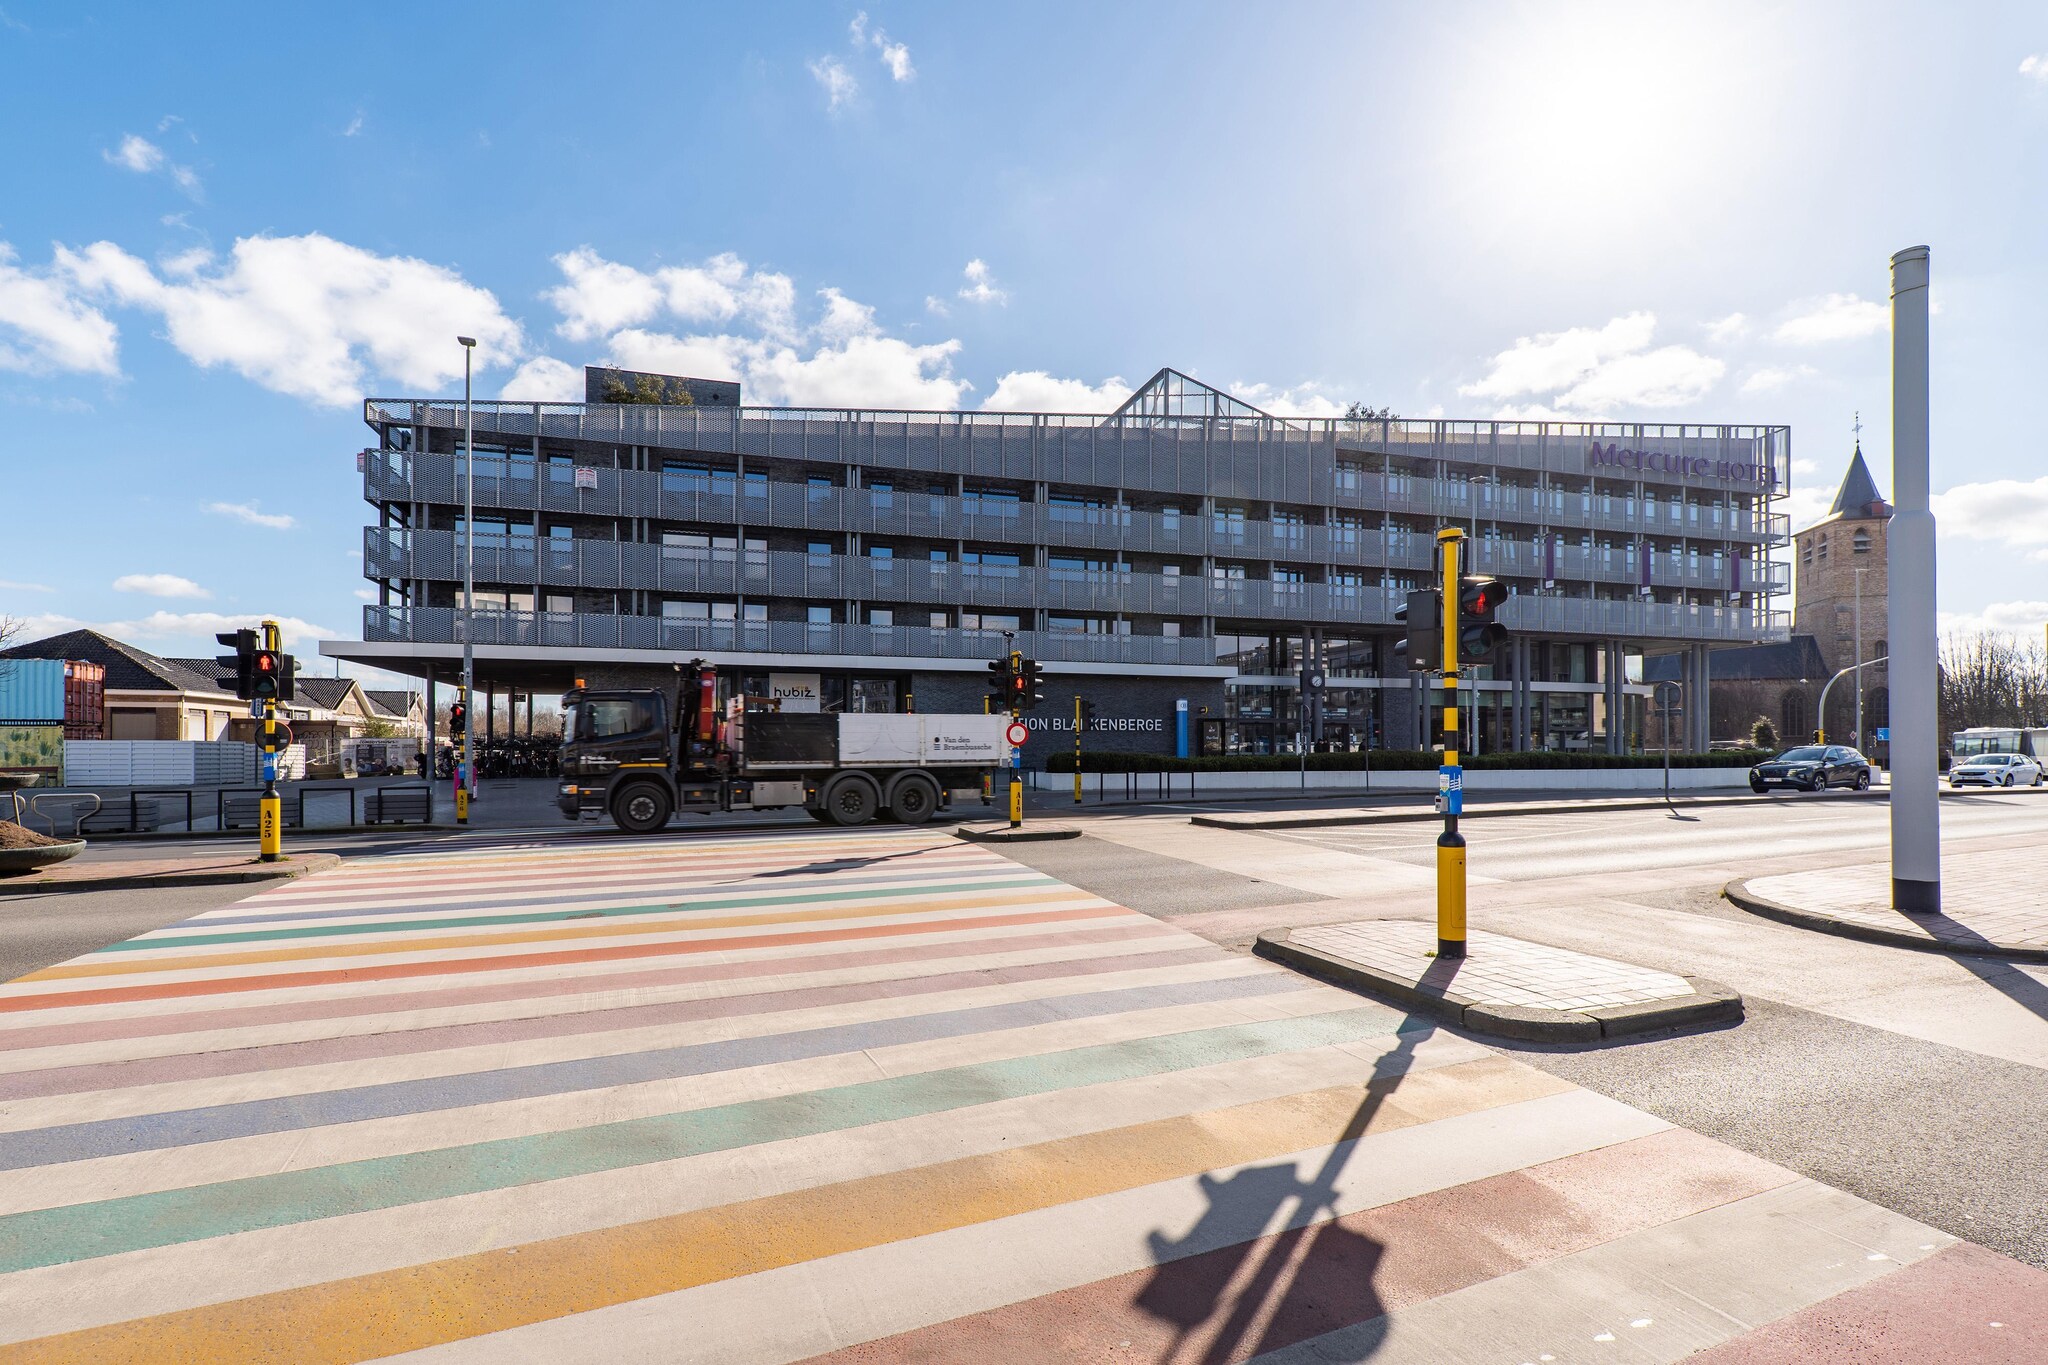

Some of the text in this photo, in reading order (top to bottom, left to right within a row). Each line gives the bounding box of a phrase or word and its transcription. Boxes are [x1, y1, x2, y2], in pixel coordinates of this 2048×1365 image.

[1592, 441, 1782, 485] Mercure HOTEL
[774, 687, 816, 697] hubiz
[263, 810, 273, 839] A25
